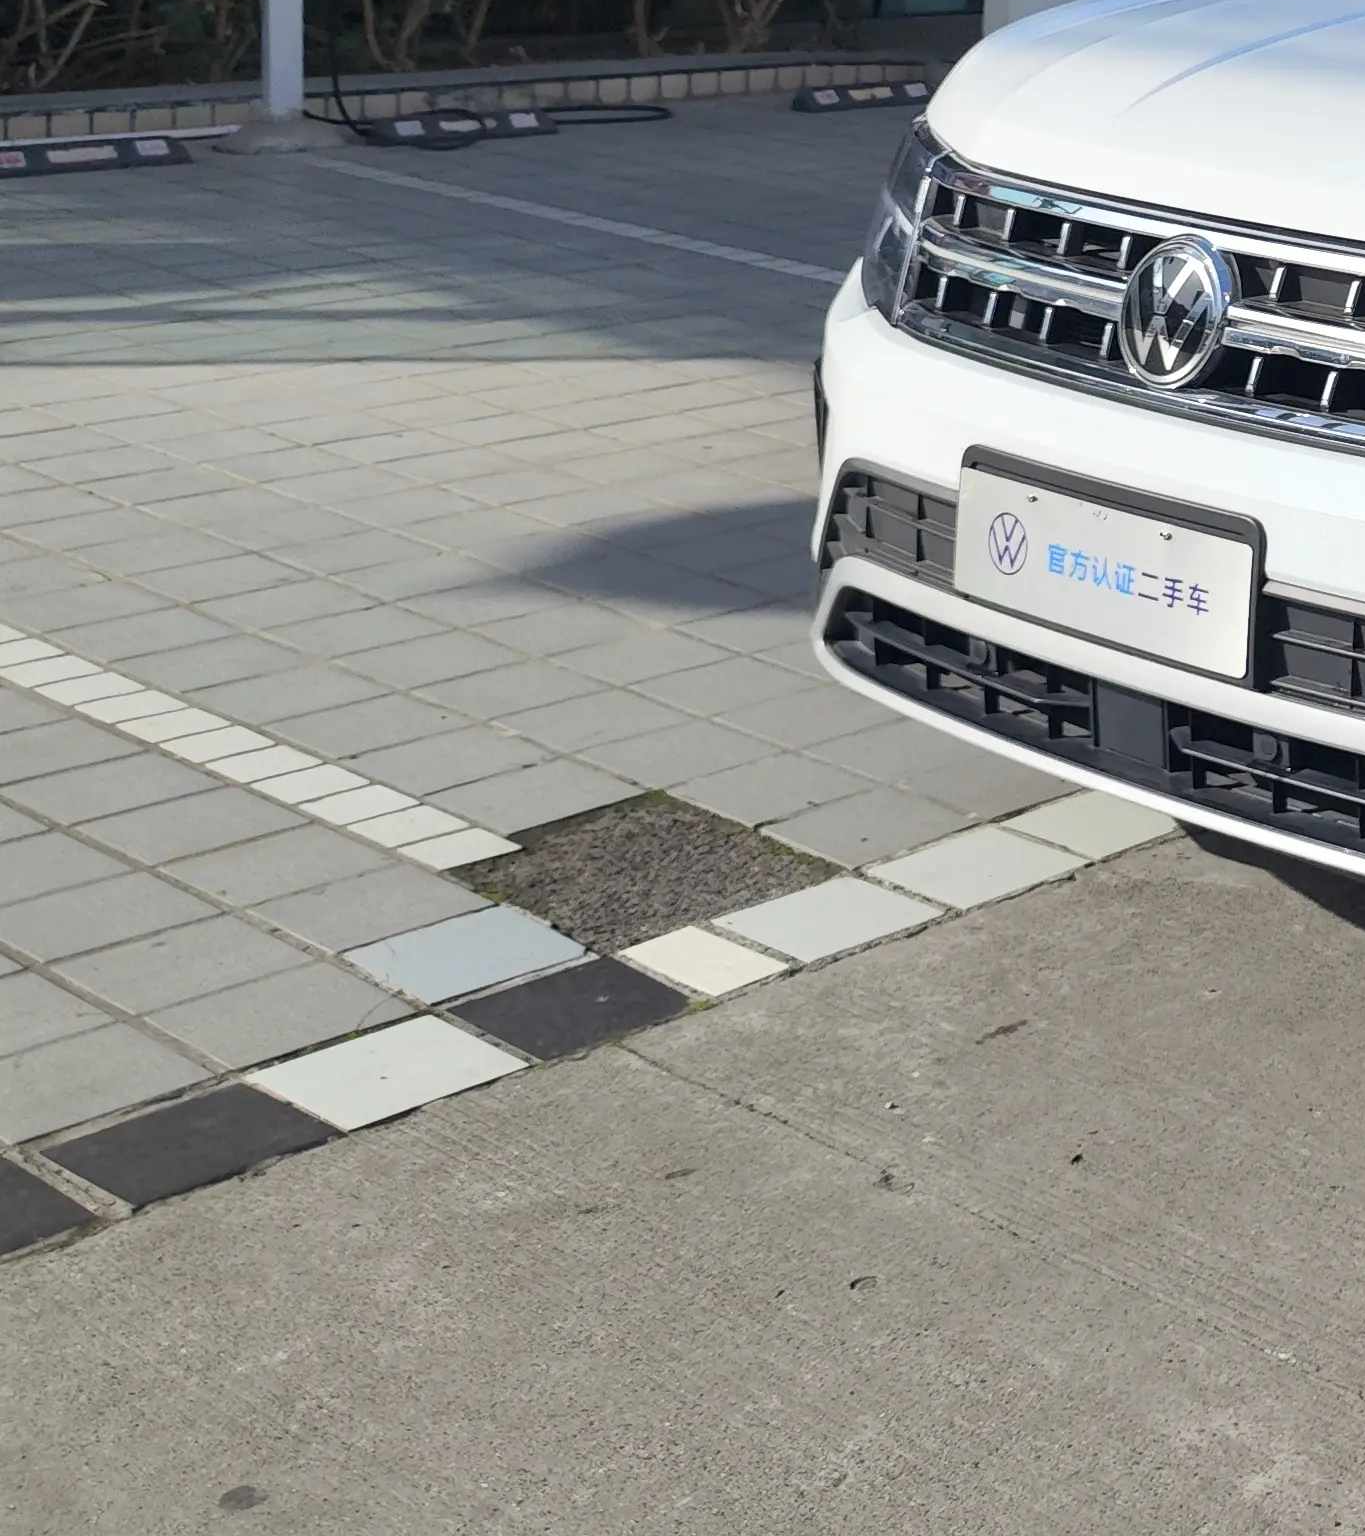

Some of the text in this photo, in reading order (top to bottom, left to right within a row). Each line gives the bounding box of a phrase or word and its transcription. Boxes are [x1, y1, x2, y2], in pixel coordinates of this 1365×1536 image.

[1047, 543, 1210, 615] 官方认证二手车
